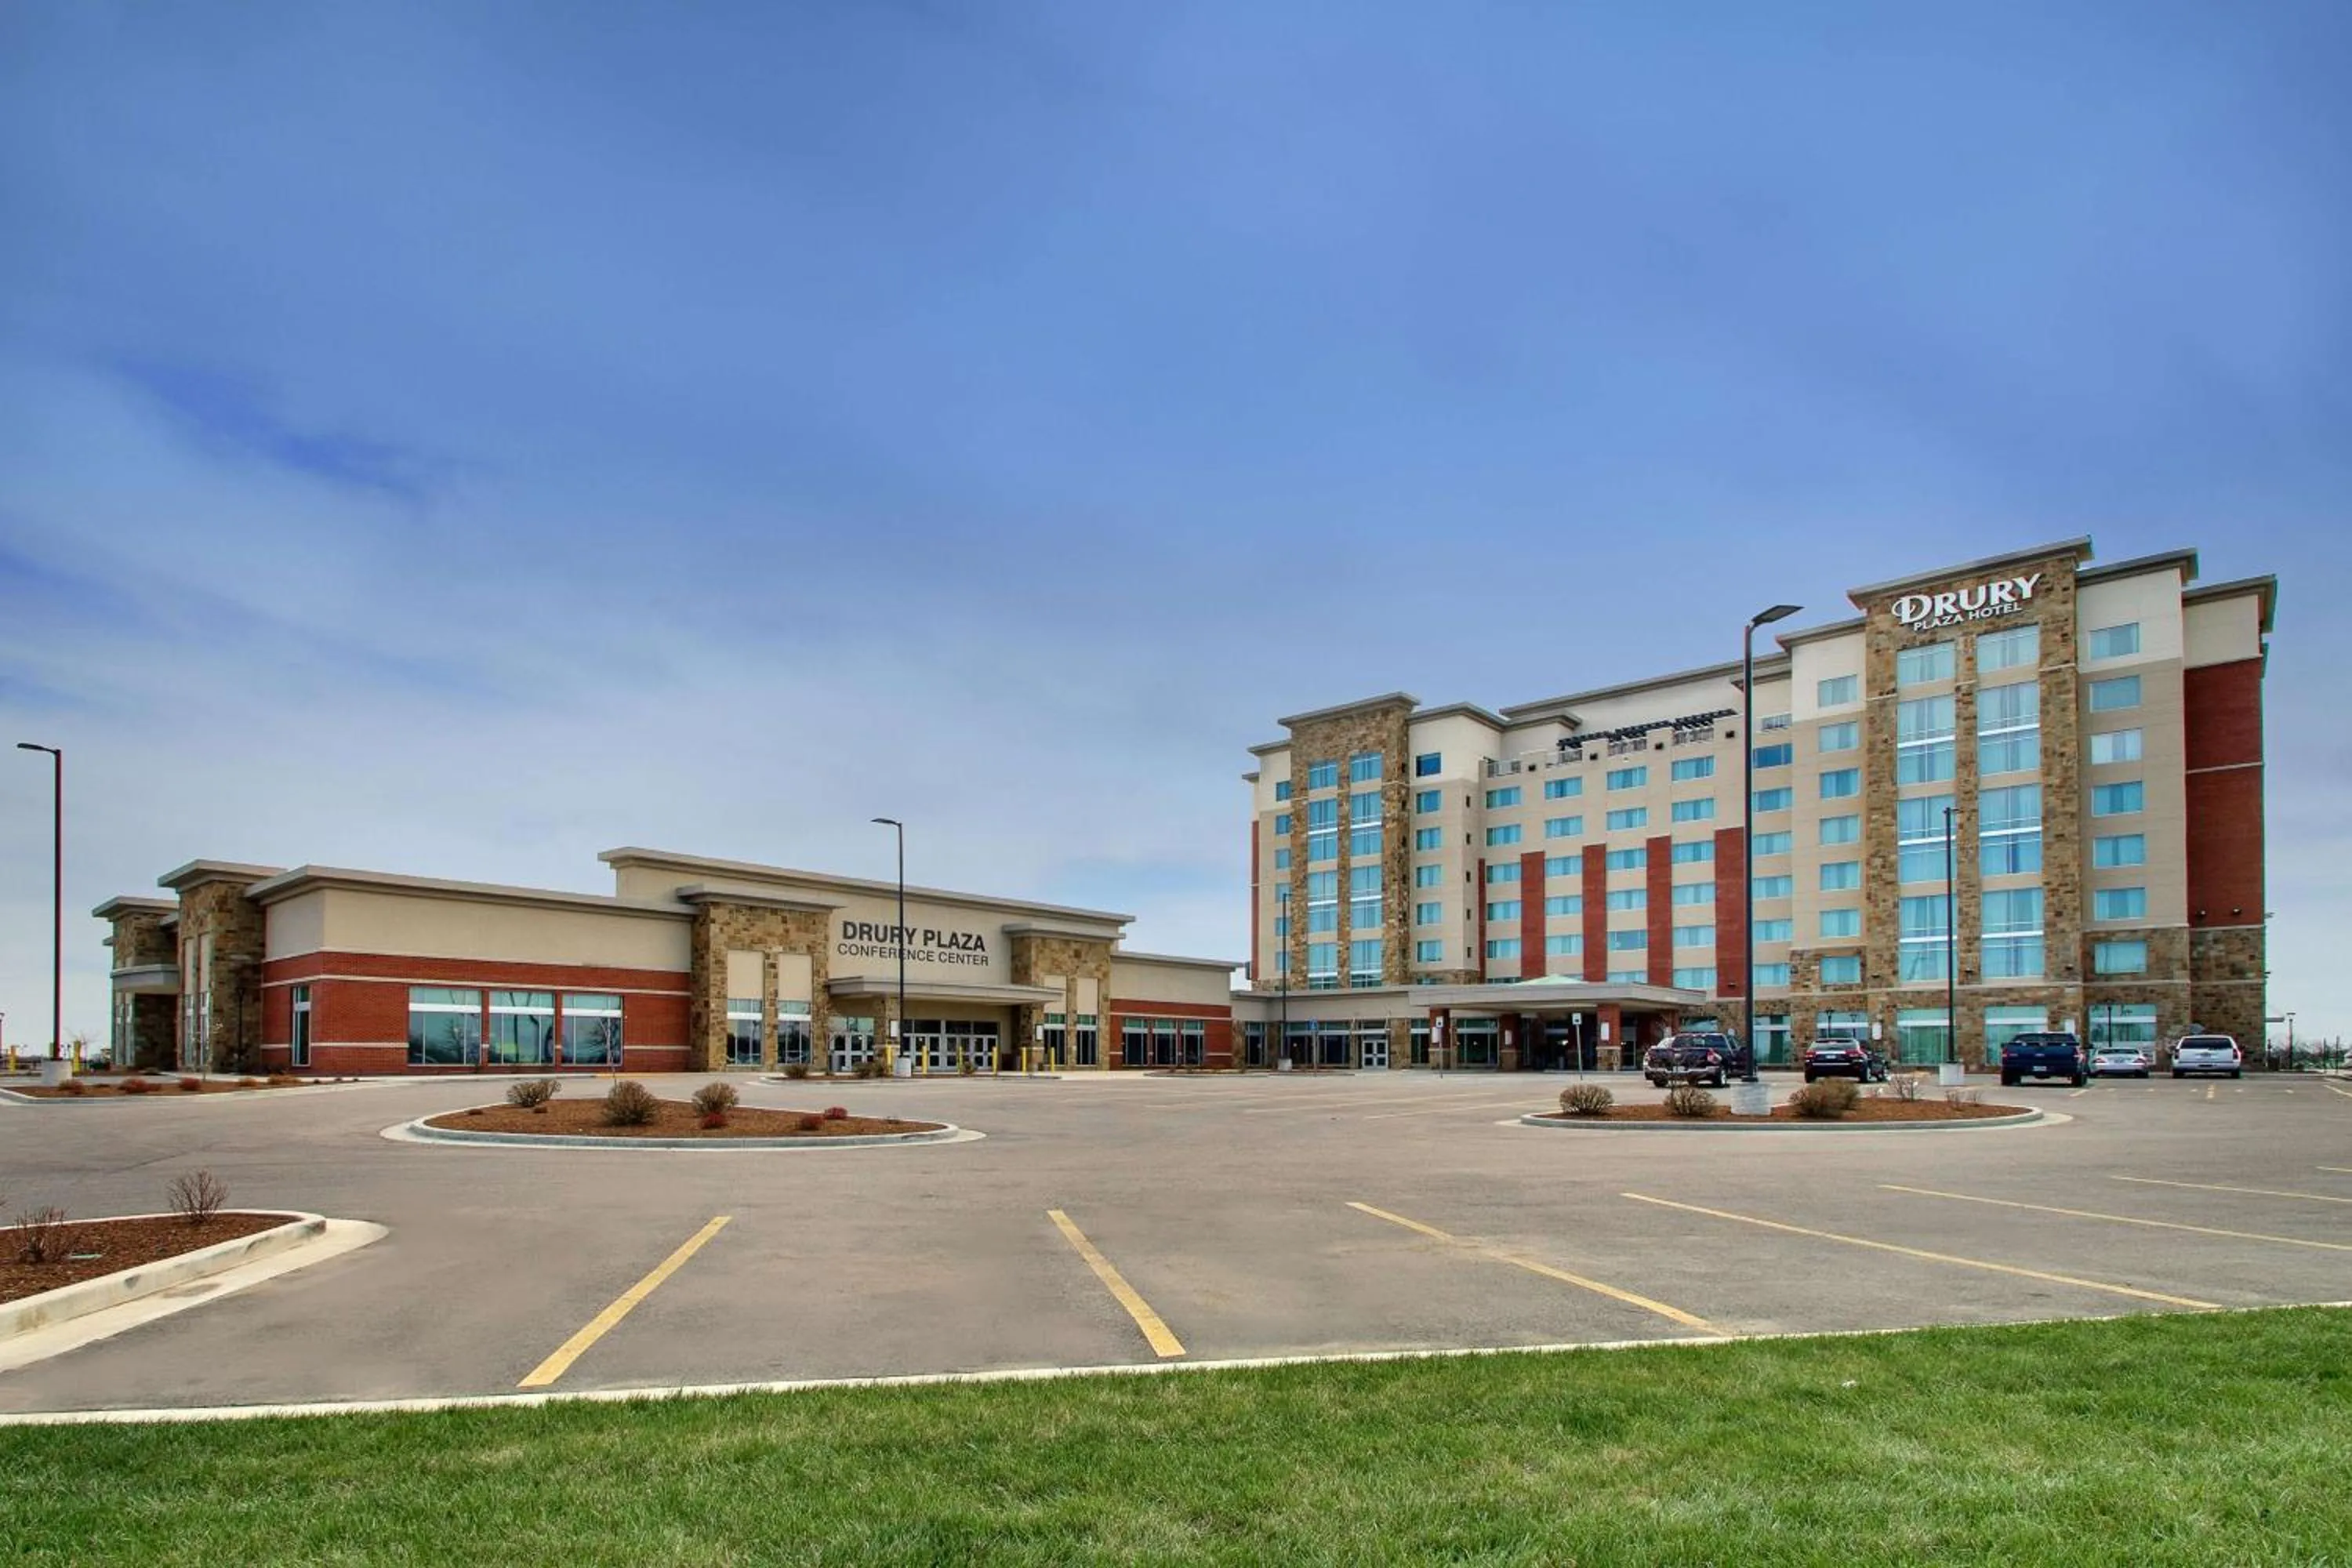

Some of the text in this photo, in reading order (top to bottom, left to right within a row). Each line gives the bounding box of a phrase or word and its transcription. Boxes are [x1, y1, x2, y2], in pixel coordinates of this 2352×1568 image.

[1891, 572, 2042, 624] DRURY
[1914, 602, 2023, 631] PLAZA HOTEL
[843, 920, 985, 952] DRURY PLAZA
[938, 951, 989, 967] CENTER
